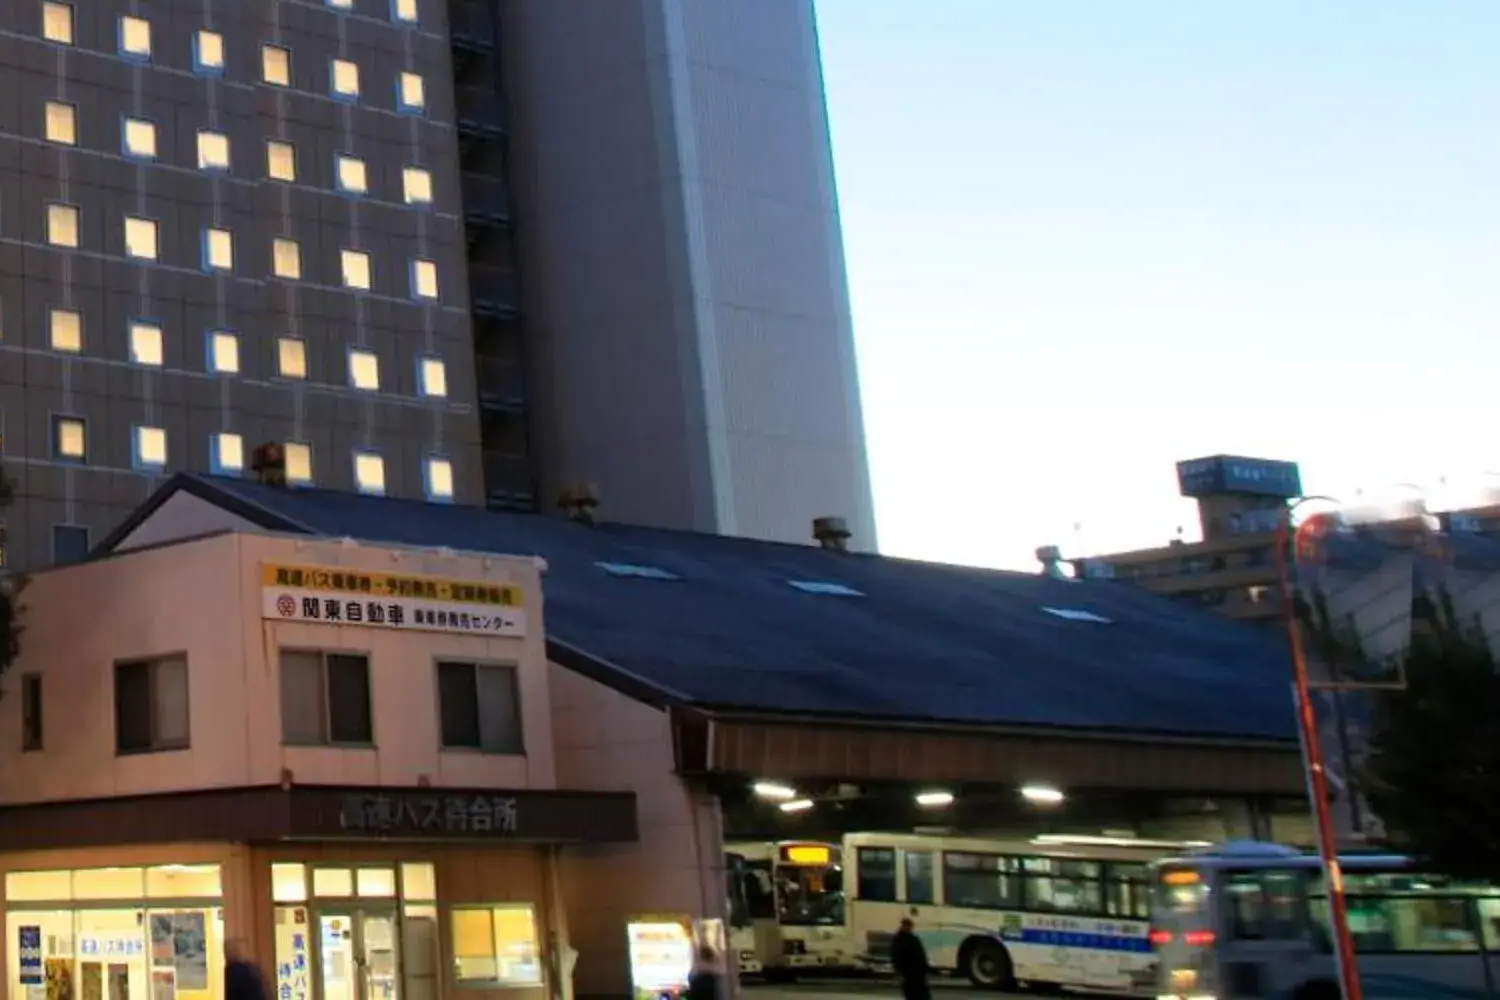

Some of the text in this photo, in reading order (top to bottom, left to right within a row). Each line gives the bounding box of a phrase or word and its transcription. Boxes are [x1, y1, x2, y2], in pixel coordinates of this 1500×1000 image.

[302, 596, 405, 626] 関東自動車
